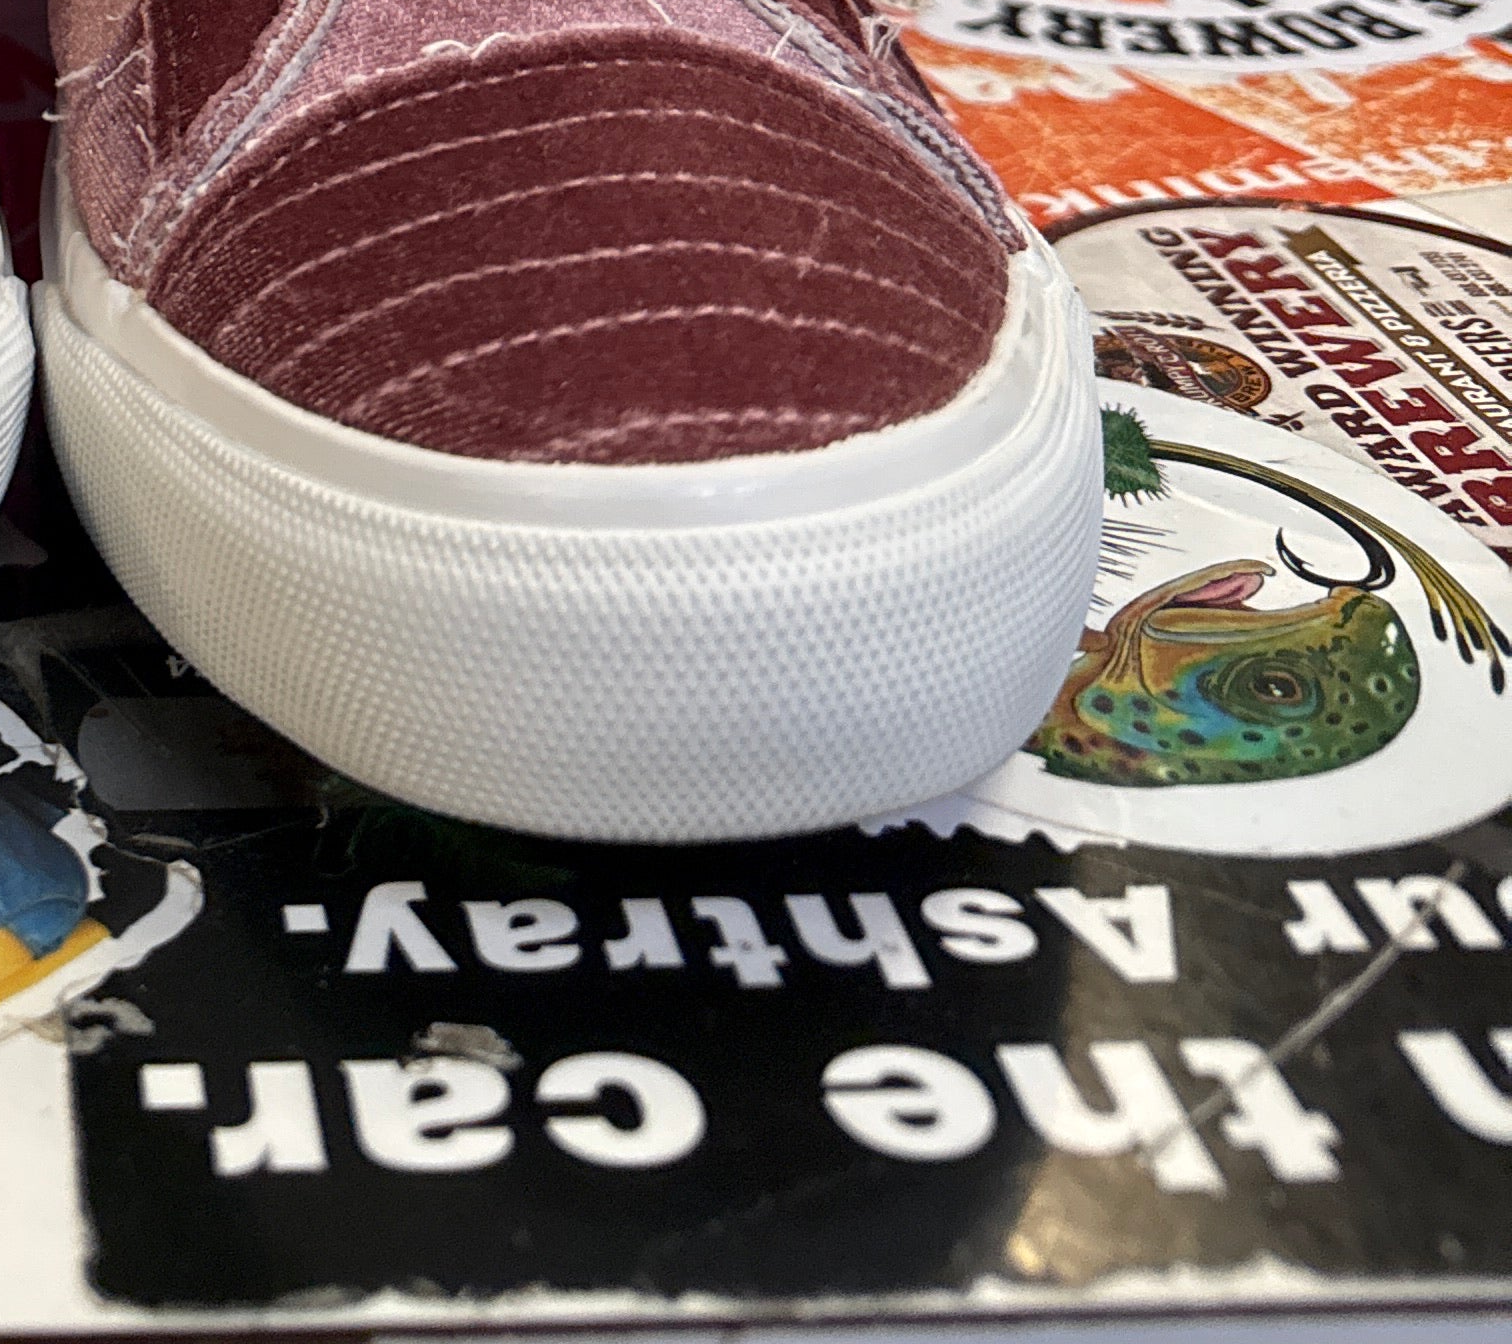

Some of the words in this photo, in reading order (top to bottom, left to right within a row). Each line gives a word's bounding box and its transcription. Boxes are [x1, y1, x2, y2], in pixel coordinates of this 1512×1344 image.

[966, 4, 1424, 59] BOWERY
[1137, 226, 1319, 379] WINNING
[1304, 249, 1415, 331] PIZZERIA
[1304, 384, 1489, 528] AWARD
[283, 880, 1180, 991] Ashtray.
[139, 1051, 707, 1176] car.
[821, 1036, 1342, 1196] the
